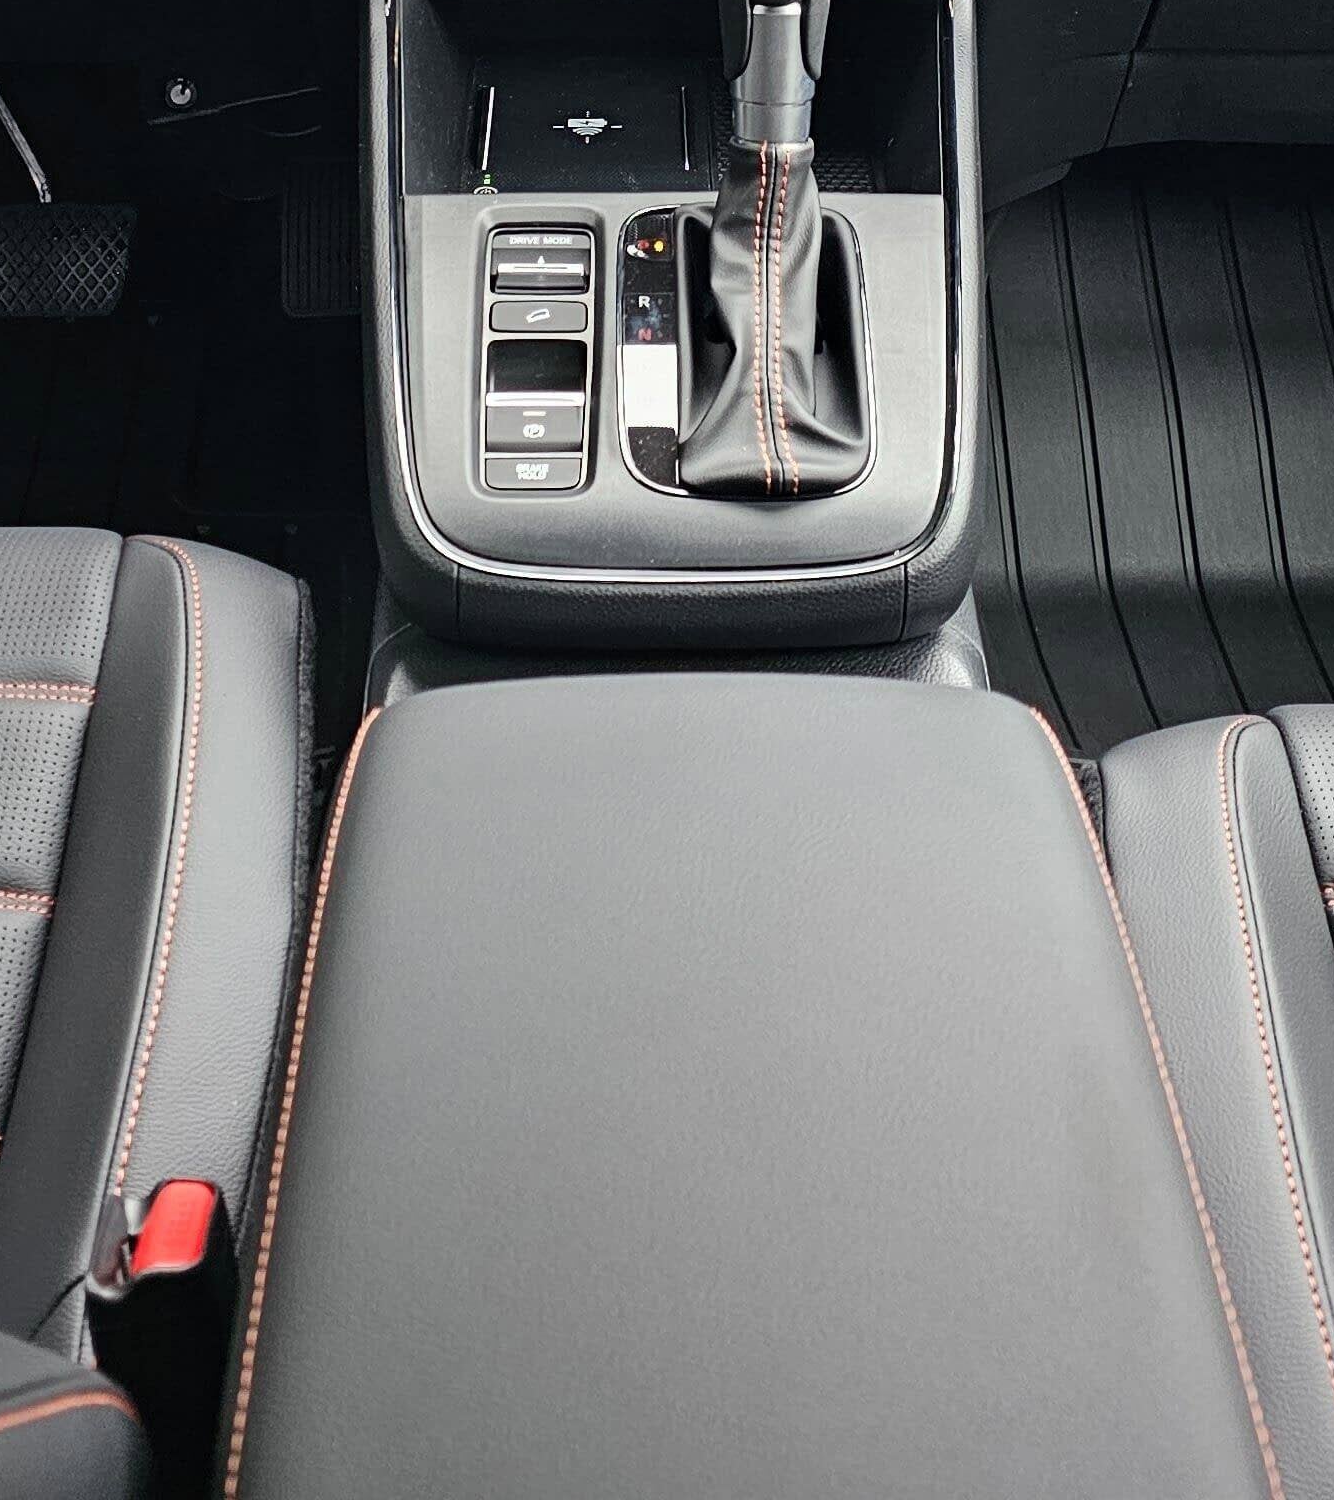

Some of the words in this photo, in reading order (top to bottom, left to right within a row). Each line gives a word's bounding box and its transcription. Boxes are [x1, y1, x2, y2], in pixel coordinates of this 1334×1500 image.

[509, 235, 539, 246] DRIVE
[542, 236, 572, 246] MODE
[637, 295, 650, 308] R
